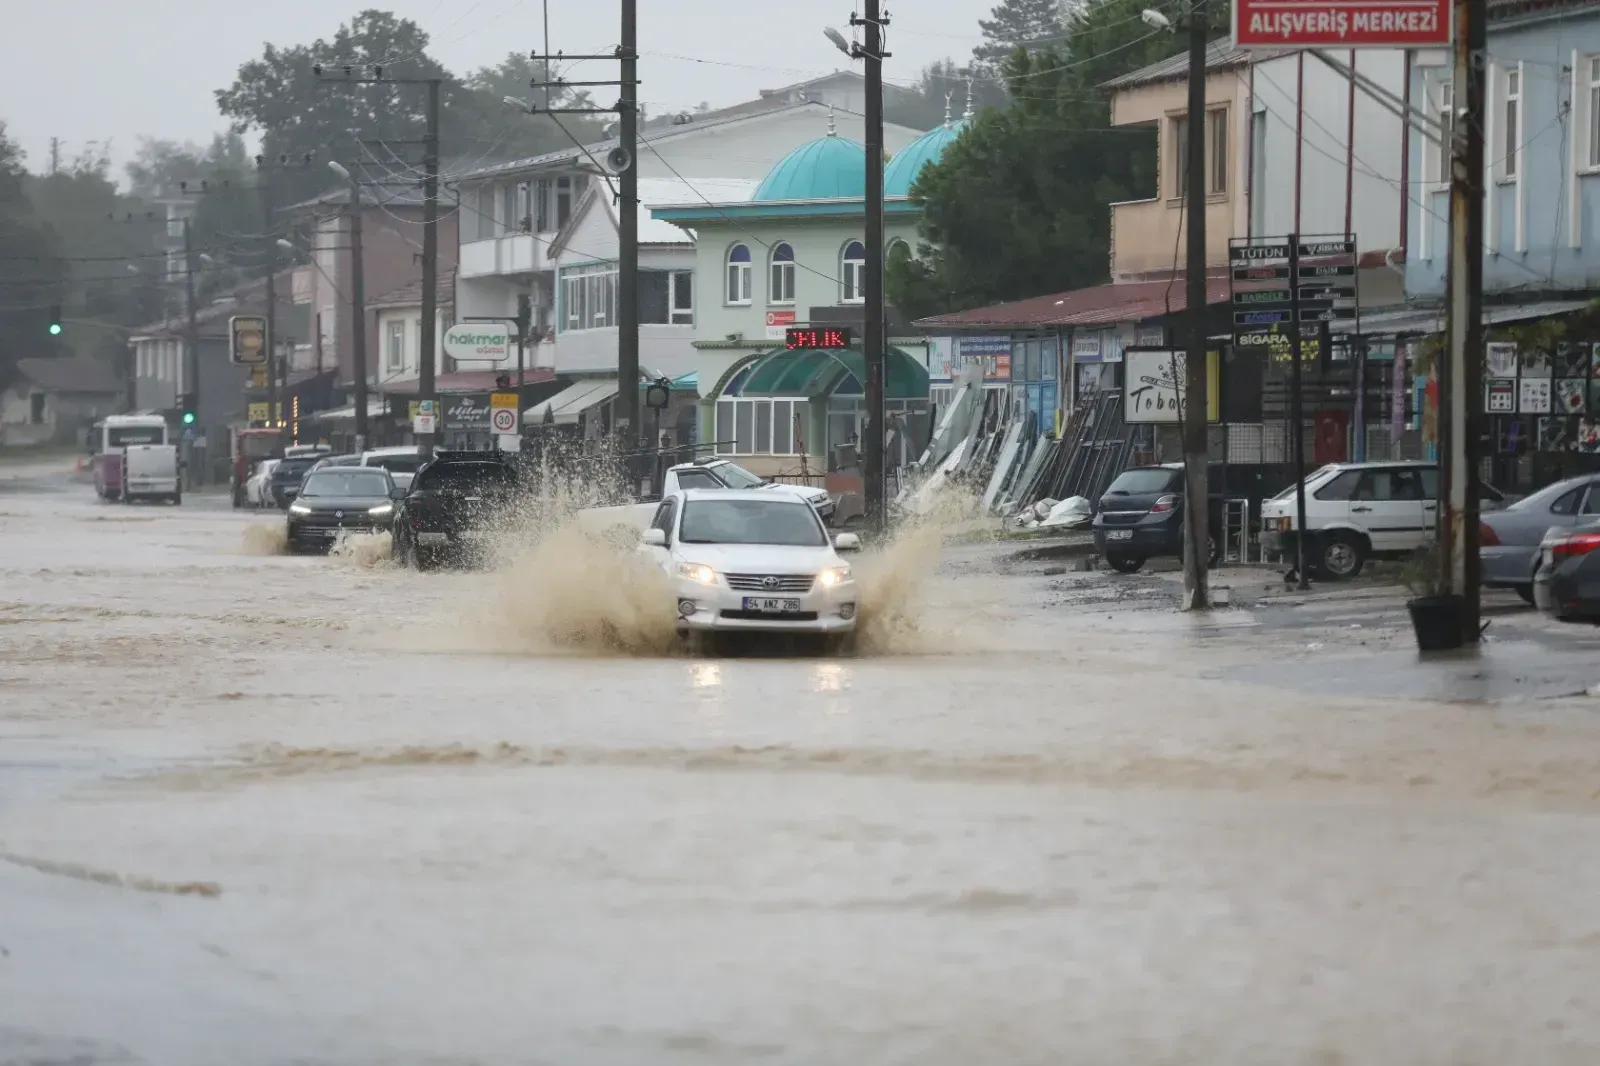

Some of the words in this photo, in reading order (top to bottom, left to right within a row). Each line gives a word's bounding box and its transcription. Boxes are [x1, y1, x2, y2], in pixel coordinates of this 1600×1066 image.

[1249, 8, 1348, 38] ALIŞVERİŞ
[1353, 7, 1438, 32] MERKEZİ
[1239, 246, 1284, 258] TÜTÜN
[448, 333, 506, 345] hakmar
[1239, 333, 1289, 346] SİGARA
[498, 415, 510, 425] 30
[748, 599, 759, 608] 54
[783, 600, 798, 610] 286
